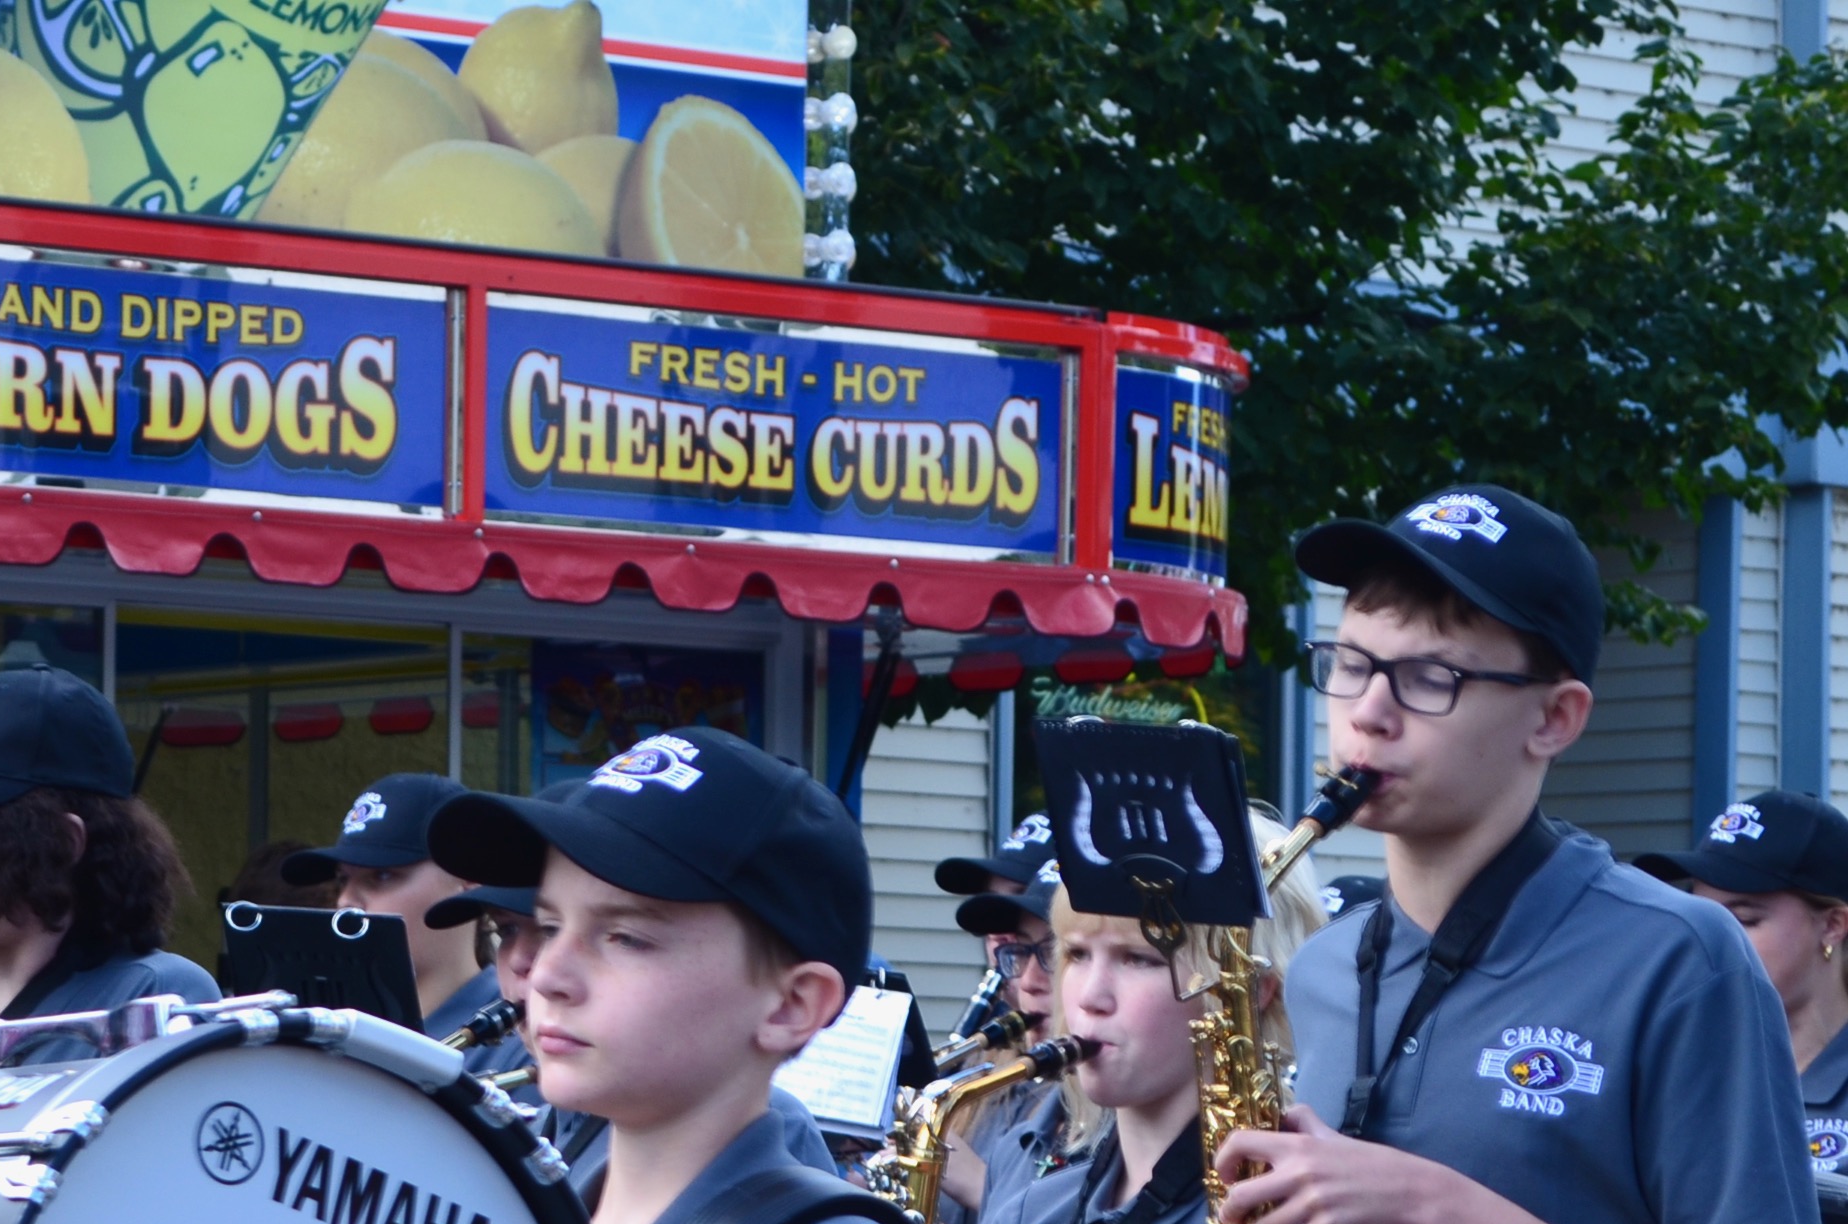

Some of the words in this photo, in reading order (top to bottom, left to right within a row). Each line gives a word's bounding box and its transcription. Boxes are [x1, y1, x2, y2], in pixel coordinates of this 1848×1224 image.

[120, 294, 304, 346] DIPPED
[142, 336, 396, 462] DOGS
[629, 341, 786, 397] FRESH
[834, 363, 925, 404] HOT
[508, 350, 795, 493] CHEESE
[811, 398, 1040, 515] CURDS
[1501, 1025, 1593, 1060] CHASKA
[1498, 1087, 1565, 1116] BAND
